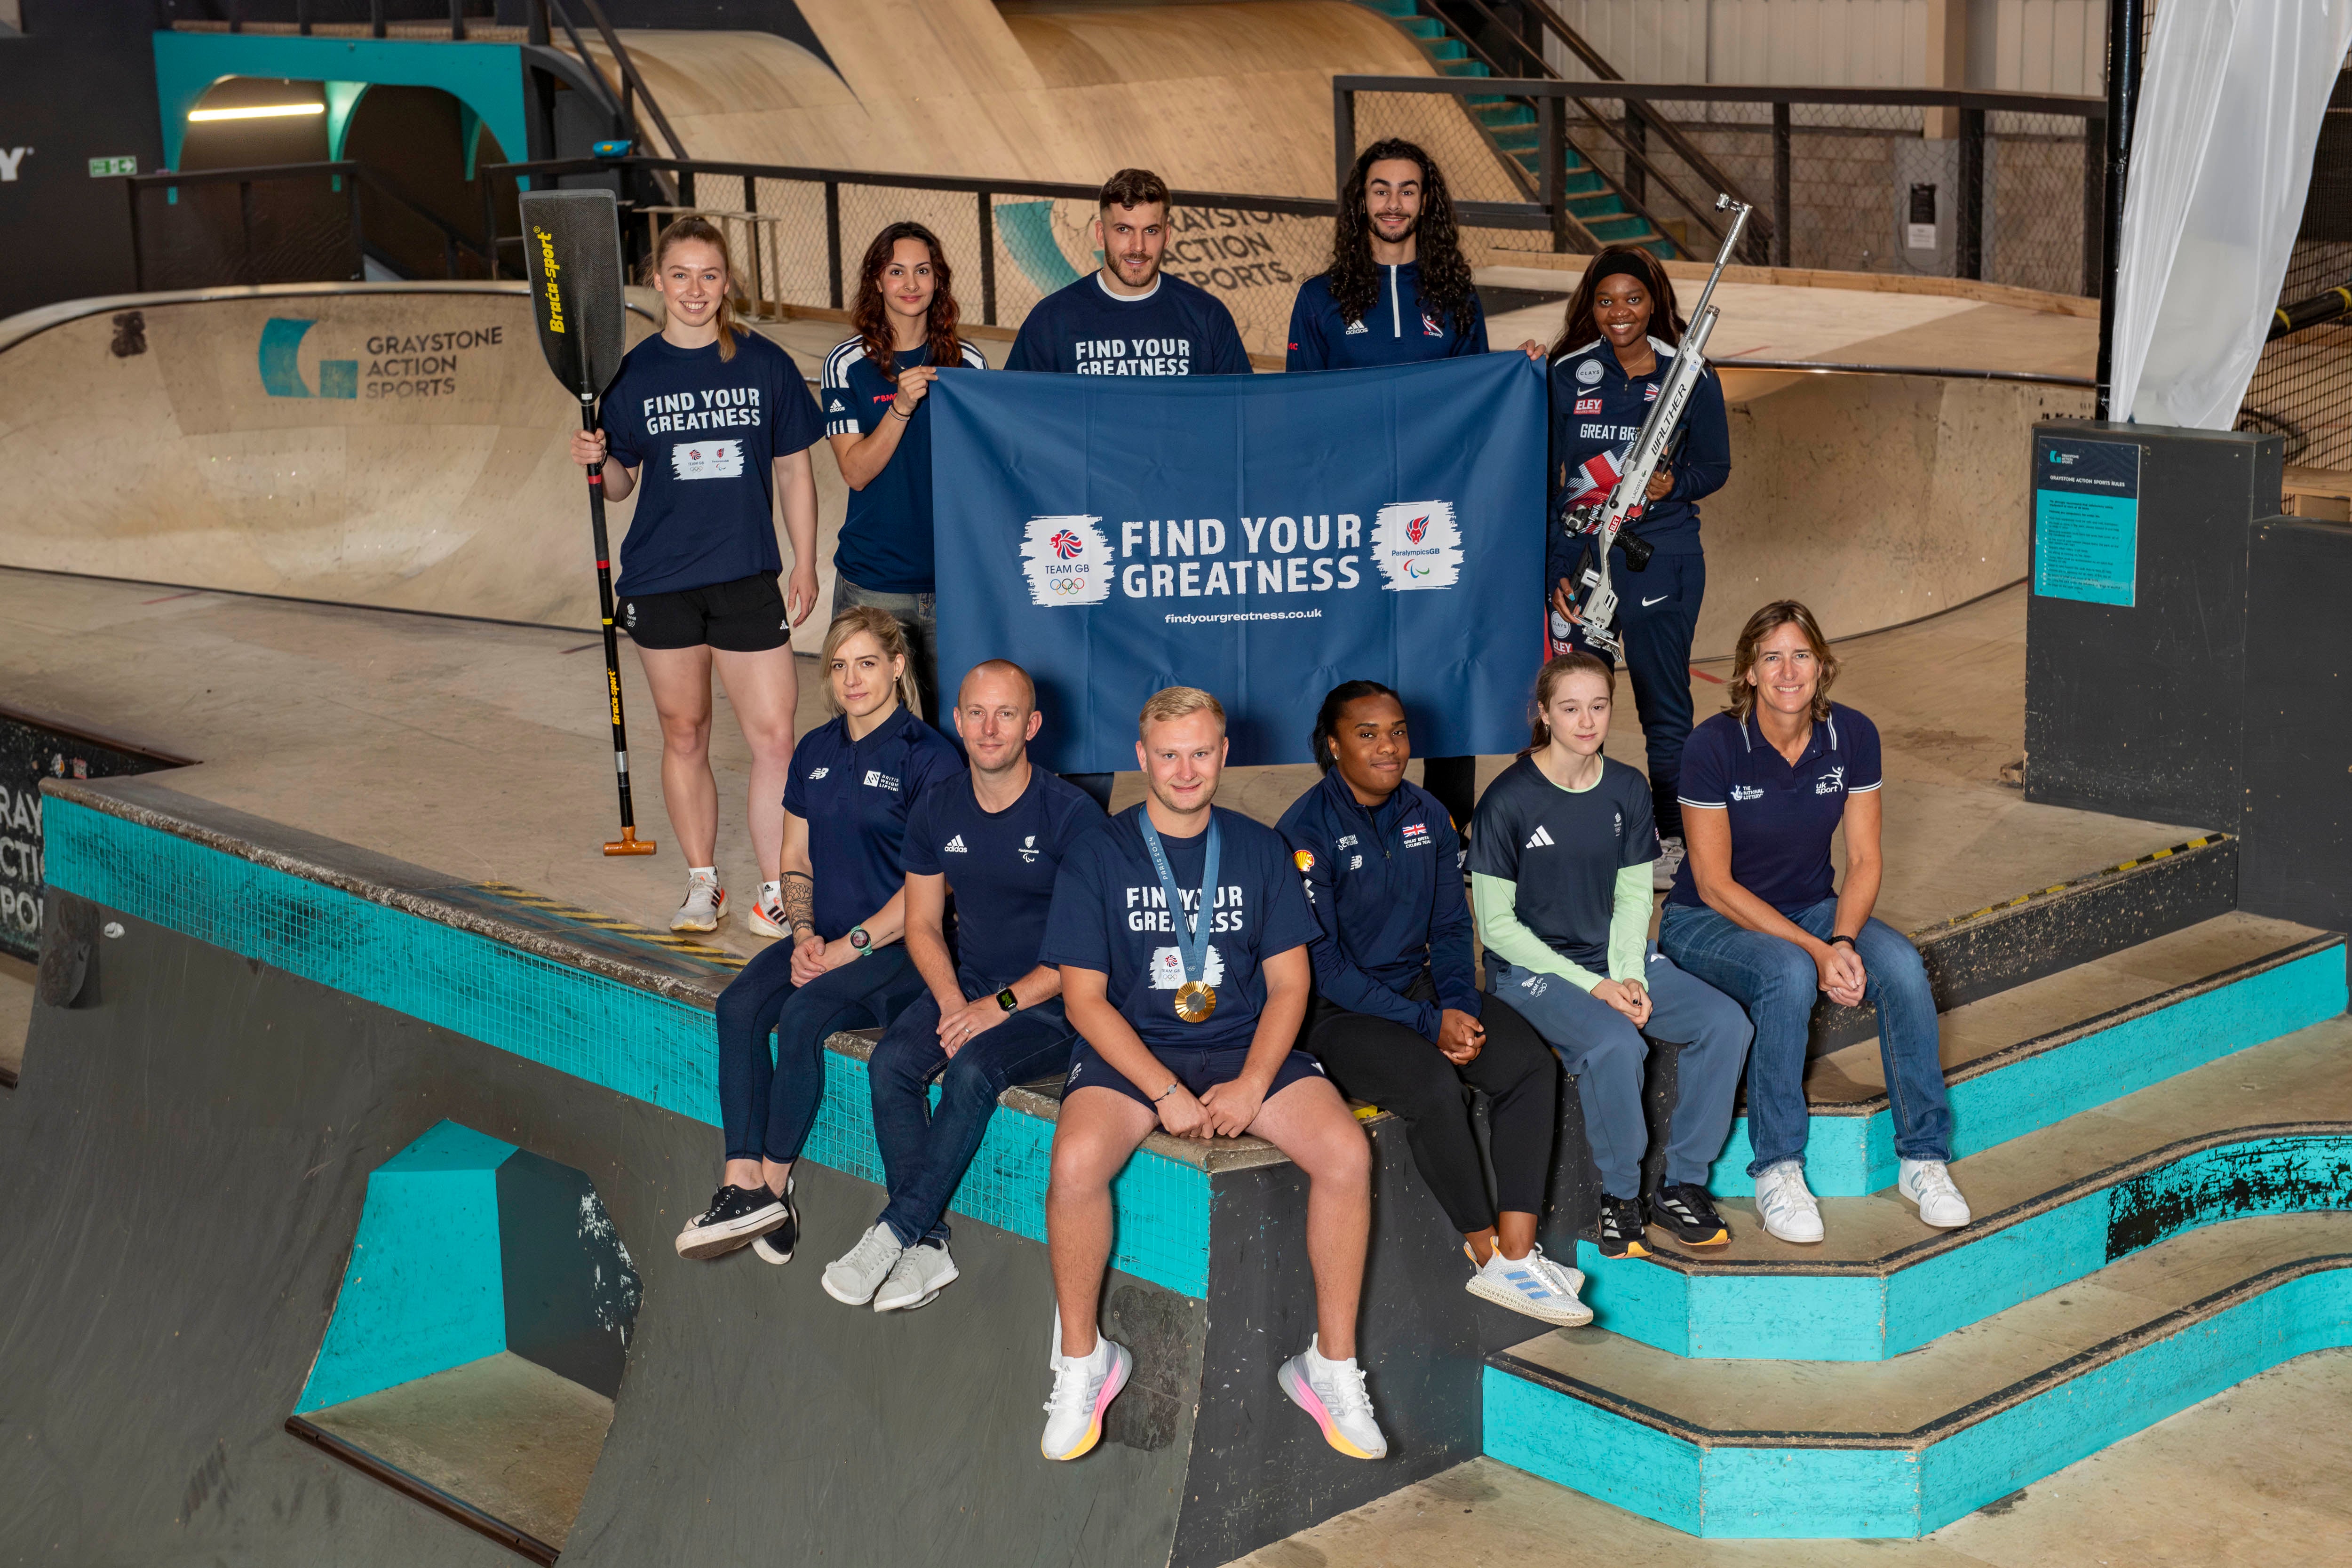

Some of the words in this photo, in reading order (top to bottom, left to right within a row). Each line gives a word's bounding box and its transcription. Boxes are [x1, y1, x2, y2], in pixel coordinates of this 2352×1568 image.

[1161, 232, 1275, 266] ACTION
[367, 326, 502, 354] GRAYSTONE
[1076, 339, 1126, 360] FIND
[1131, 338, 1190, 357] YOUR
[367, 355, 457, 377] ACTION
[1077, 358, 1189, 375] GREATNESS
[366, 378, 455, 399] SPORTS
[644, 392, 695, 417] FIND
[700, 388, 760, 408] YOUR
[1576, 399, 1601, 410] ELEY
[646, 408, 760, 435] GREATNESS
[1651, 383, 1686, 455] WALTHER
[1580, 423, 1617, 439] GREAT
[1631, 478, 1643, 499] LACOSTE
[1609, 517, 1620, 531] ELEY
[1122, 518, 1225, 557] FIND
[1240, 514, 1361, 554] YOUR
[1391, 548, 1440, 557] ParalympicsGB
[1045, 565, 1072, 574] TEAM
[1075, 564, 1089, 573] GB
[1122, 555, 1360, 598] GREATNESS
[1165, 609, 1322, 624] findyourgreatness.co.uk
[1553, 638, 1571, 653] ELEY
[879, 783, 898, 792] LIFTIN
[1816, 785, 1838, 795] sport
[1149, 837, 1160, 857] 2024
[1156, 858, 1168, 880] PARIS
[1127, 886, 1183, 908] FIN
[1530, 983, 1539, 996] TEAM
